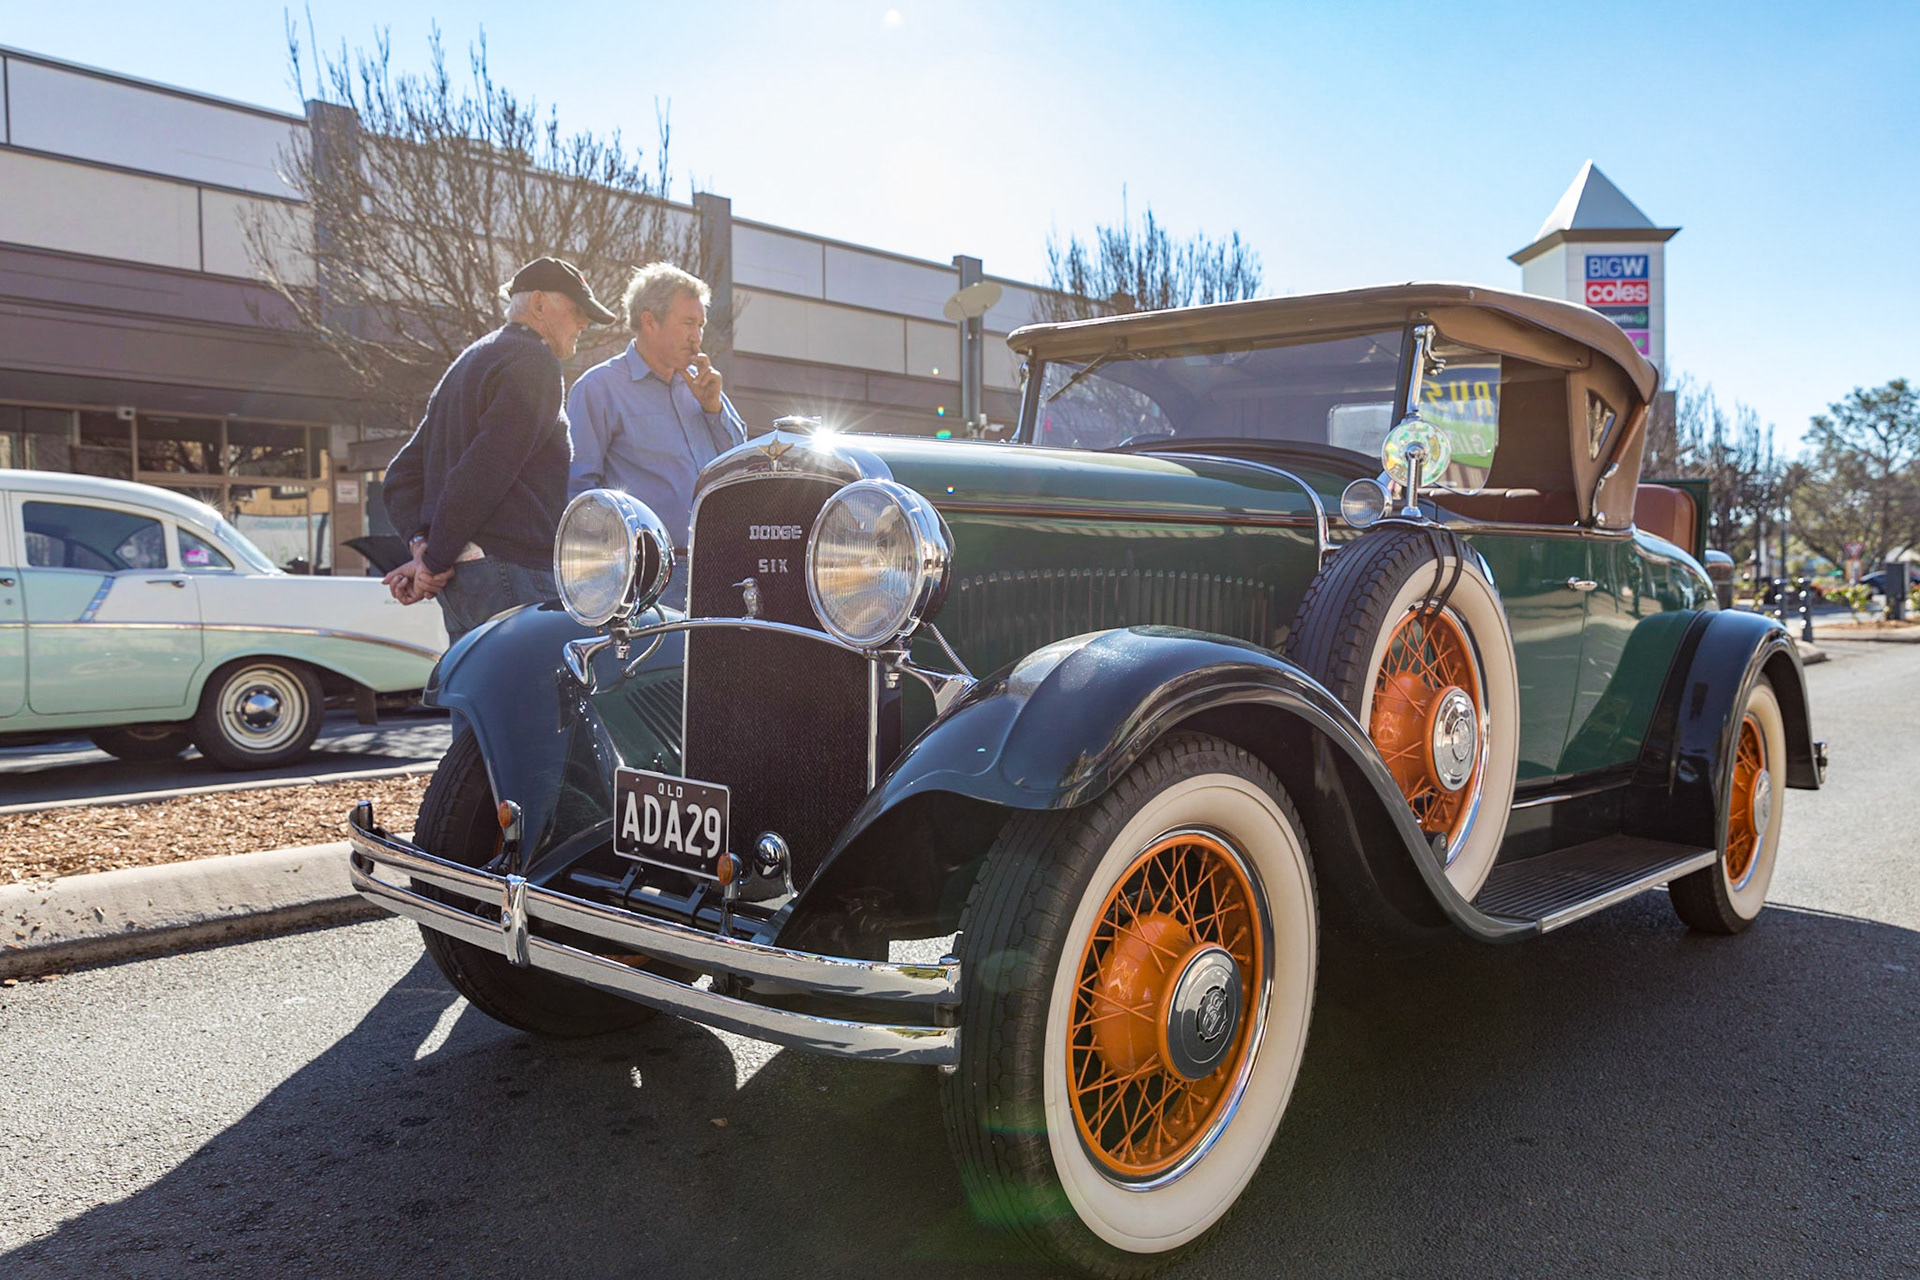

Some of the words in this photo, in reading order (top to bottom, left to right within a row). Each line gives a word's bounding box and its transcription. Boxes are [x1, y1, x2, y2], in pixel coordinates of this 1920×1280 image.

[1587, 281, 1647, 302] coles
[749, 525, 803, 540] DODGE
[758, 558, 788, 573] SIX
[658, 782, 683, 798] QLD
[621, 791, 721, 859] ADA29
